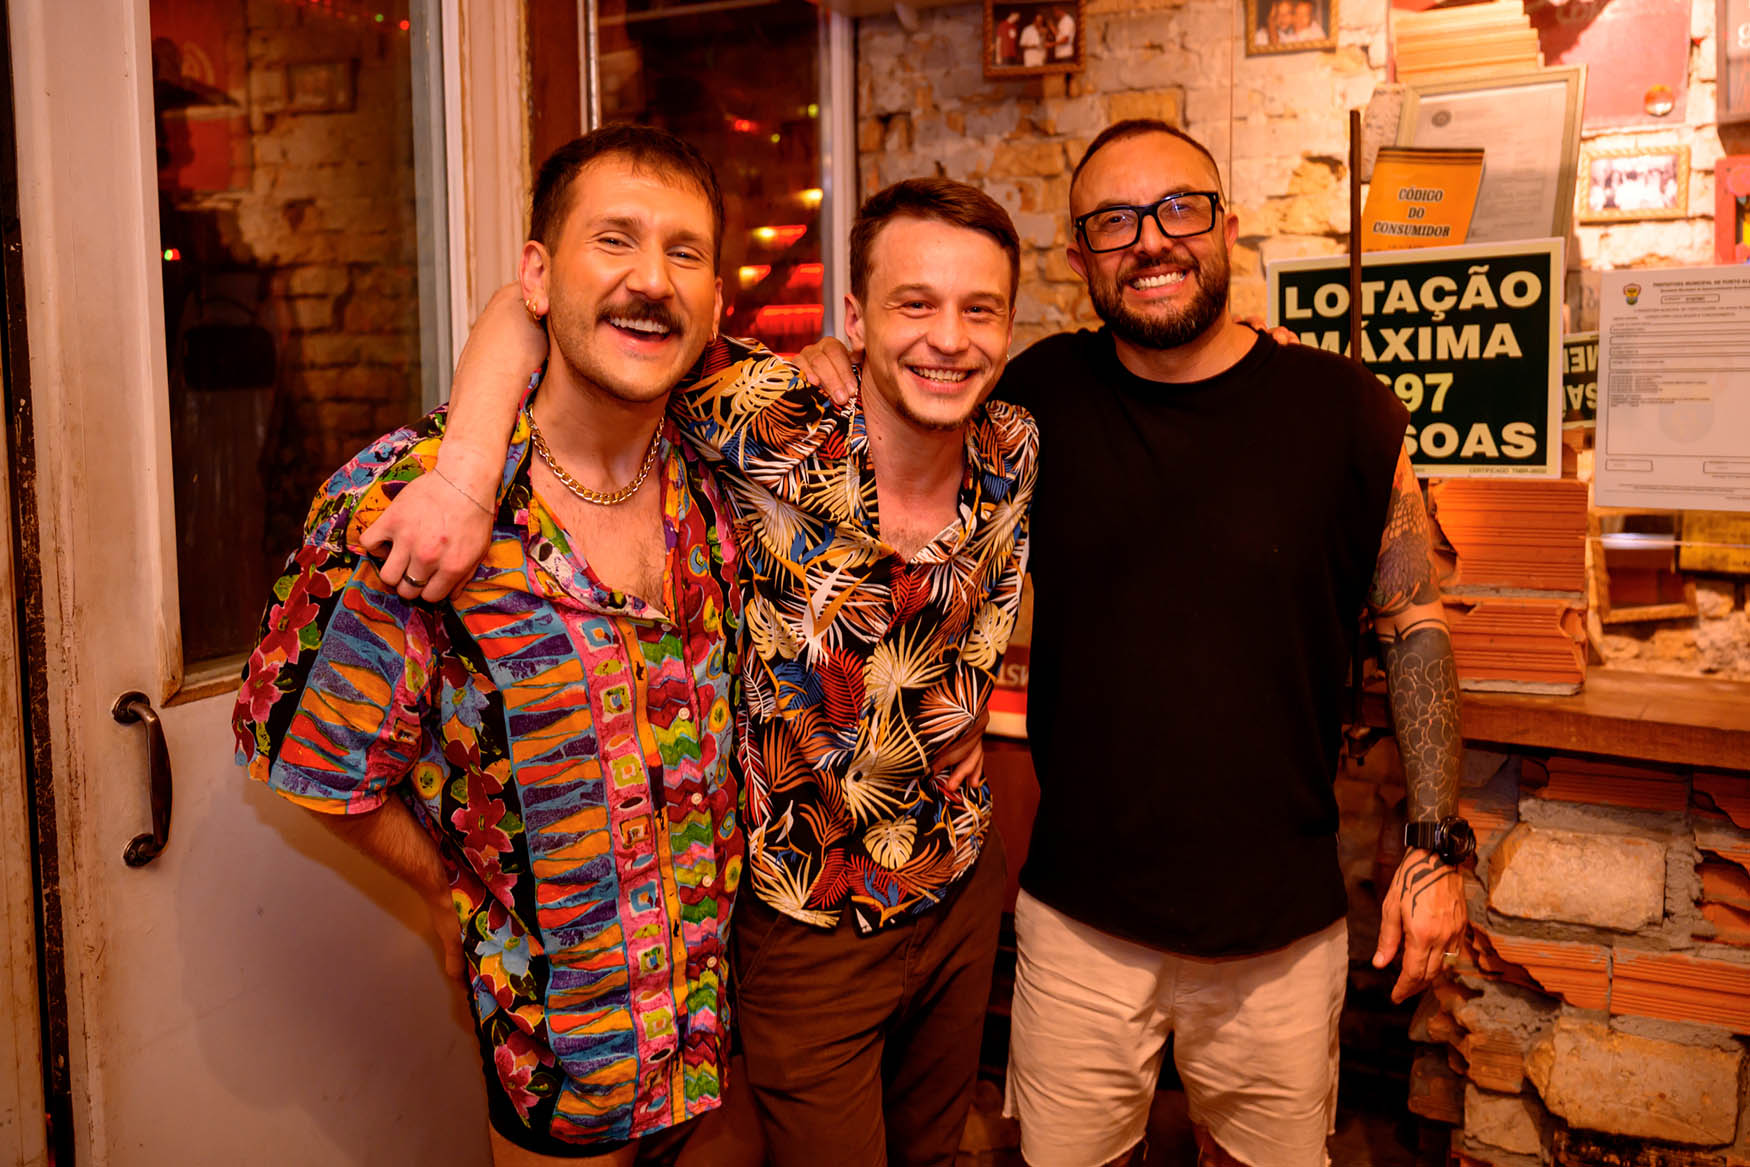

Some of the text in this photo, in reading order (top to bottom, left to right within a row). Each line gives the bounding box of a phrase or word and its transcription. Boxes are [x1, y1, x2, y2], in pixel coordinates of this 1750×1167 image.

[1398, 185, 1443, 202] CÓDIGO
[1408, 207, 1425, 219] DO
[1373, 221, 1450, 237] CONSUMIDOR
[1285, 264, 1542, 321] LOTAÇÃO
[1375, 373, 1453, 413] 97
